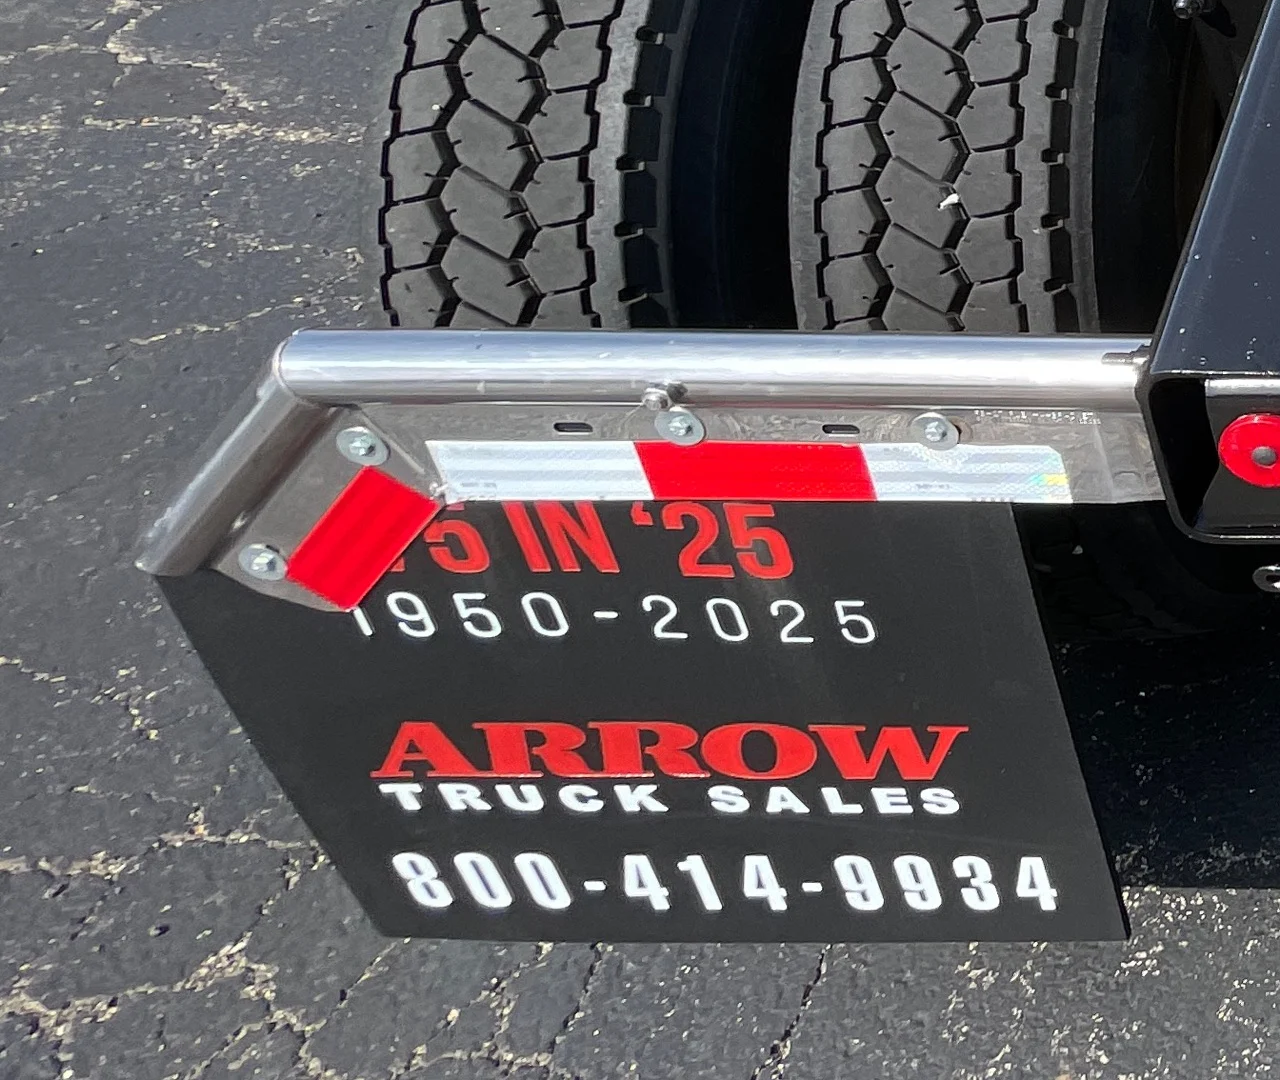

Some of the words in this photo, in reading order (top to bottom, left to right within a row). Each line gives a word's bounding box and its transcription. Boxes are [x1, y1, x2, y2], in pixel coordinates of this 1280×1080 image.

[502, 501, 619, 573] IN
[352, 590, 877, 645] 1950-2025
[369, 719, 970, 782] ARROW
[377, 782, 670, 814] TRUCK
[707, 784, 961, 816] SALES
[390, 850, 1060, 913] 800-414-9934
